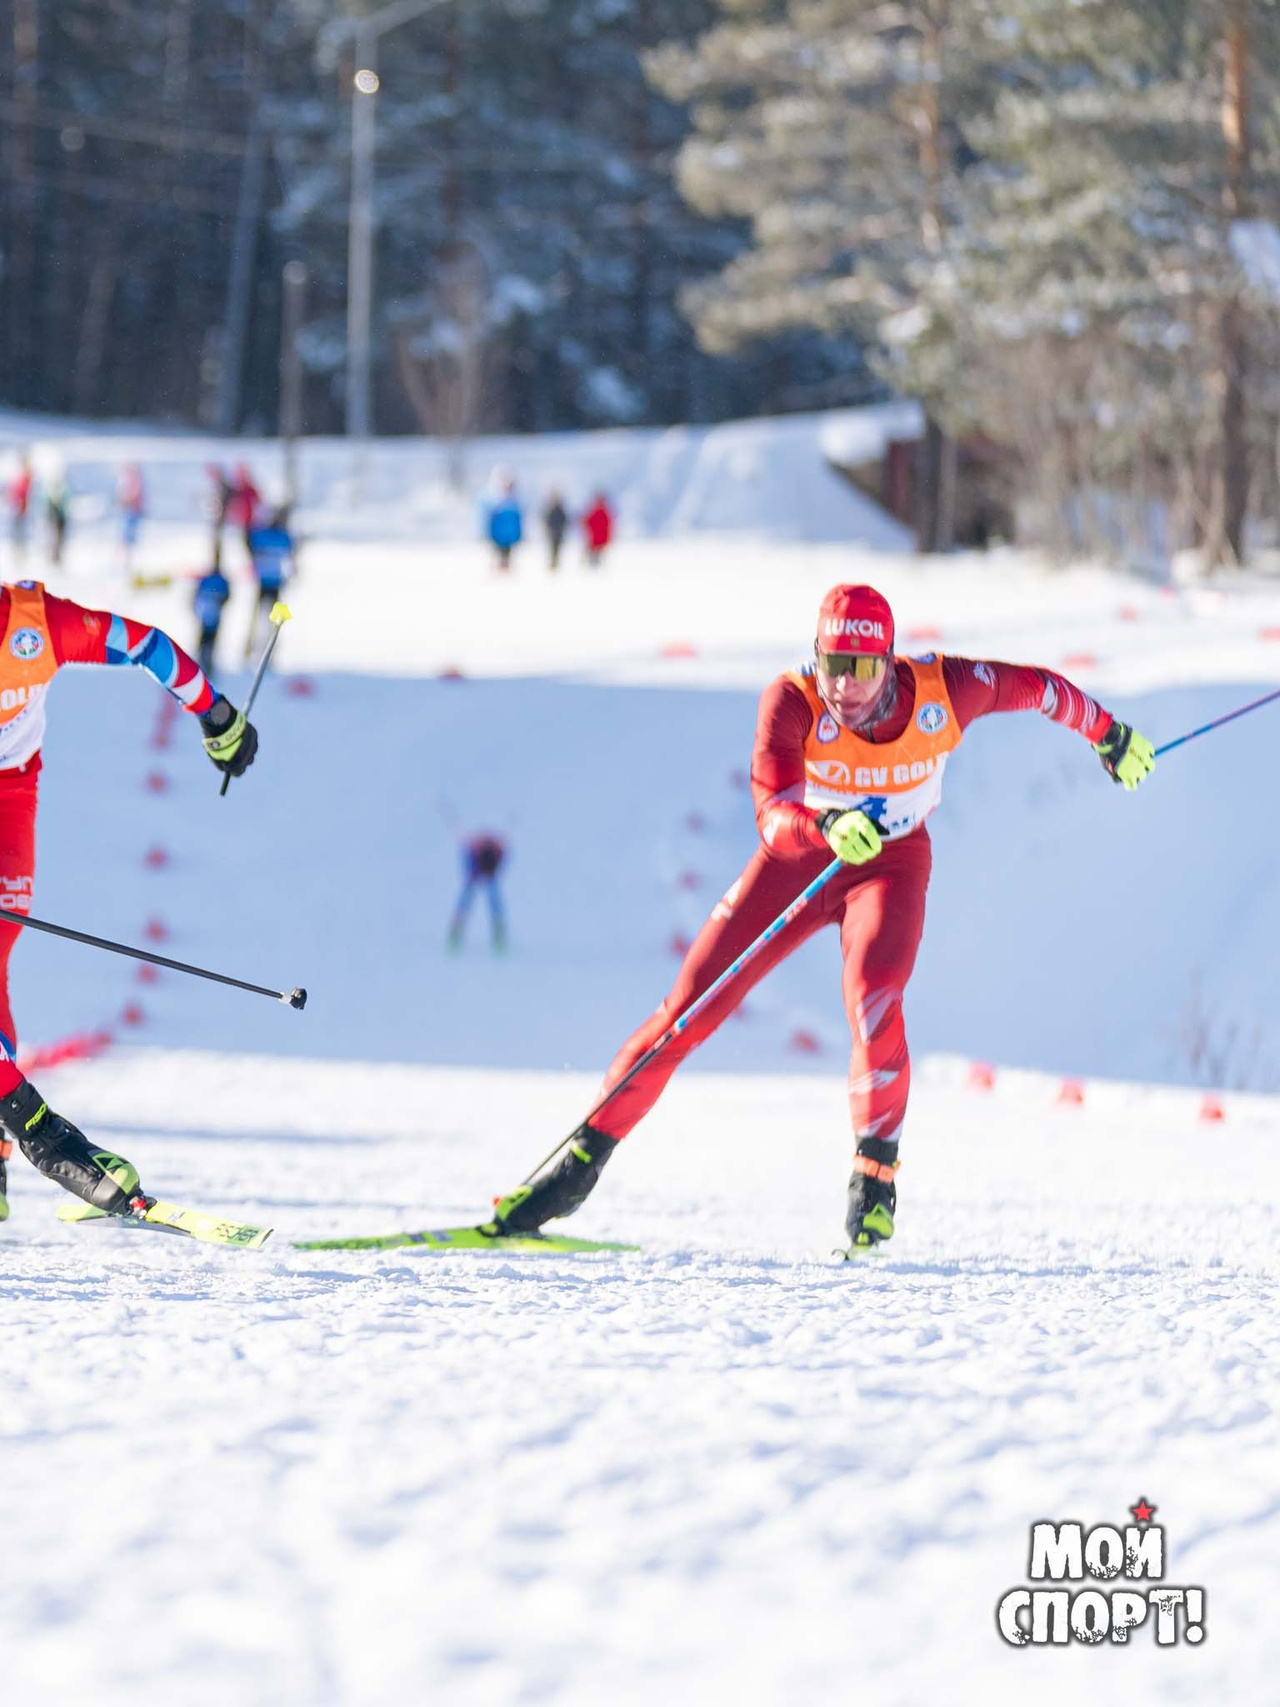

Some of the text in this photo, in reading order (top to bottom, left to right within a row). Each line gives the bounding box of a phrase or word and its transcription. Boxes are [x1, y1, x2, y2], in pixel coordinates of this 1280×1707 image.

[824, 618, 885, 640] LUKOIL
[854, 757, 937, 787] GV GOL
